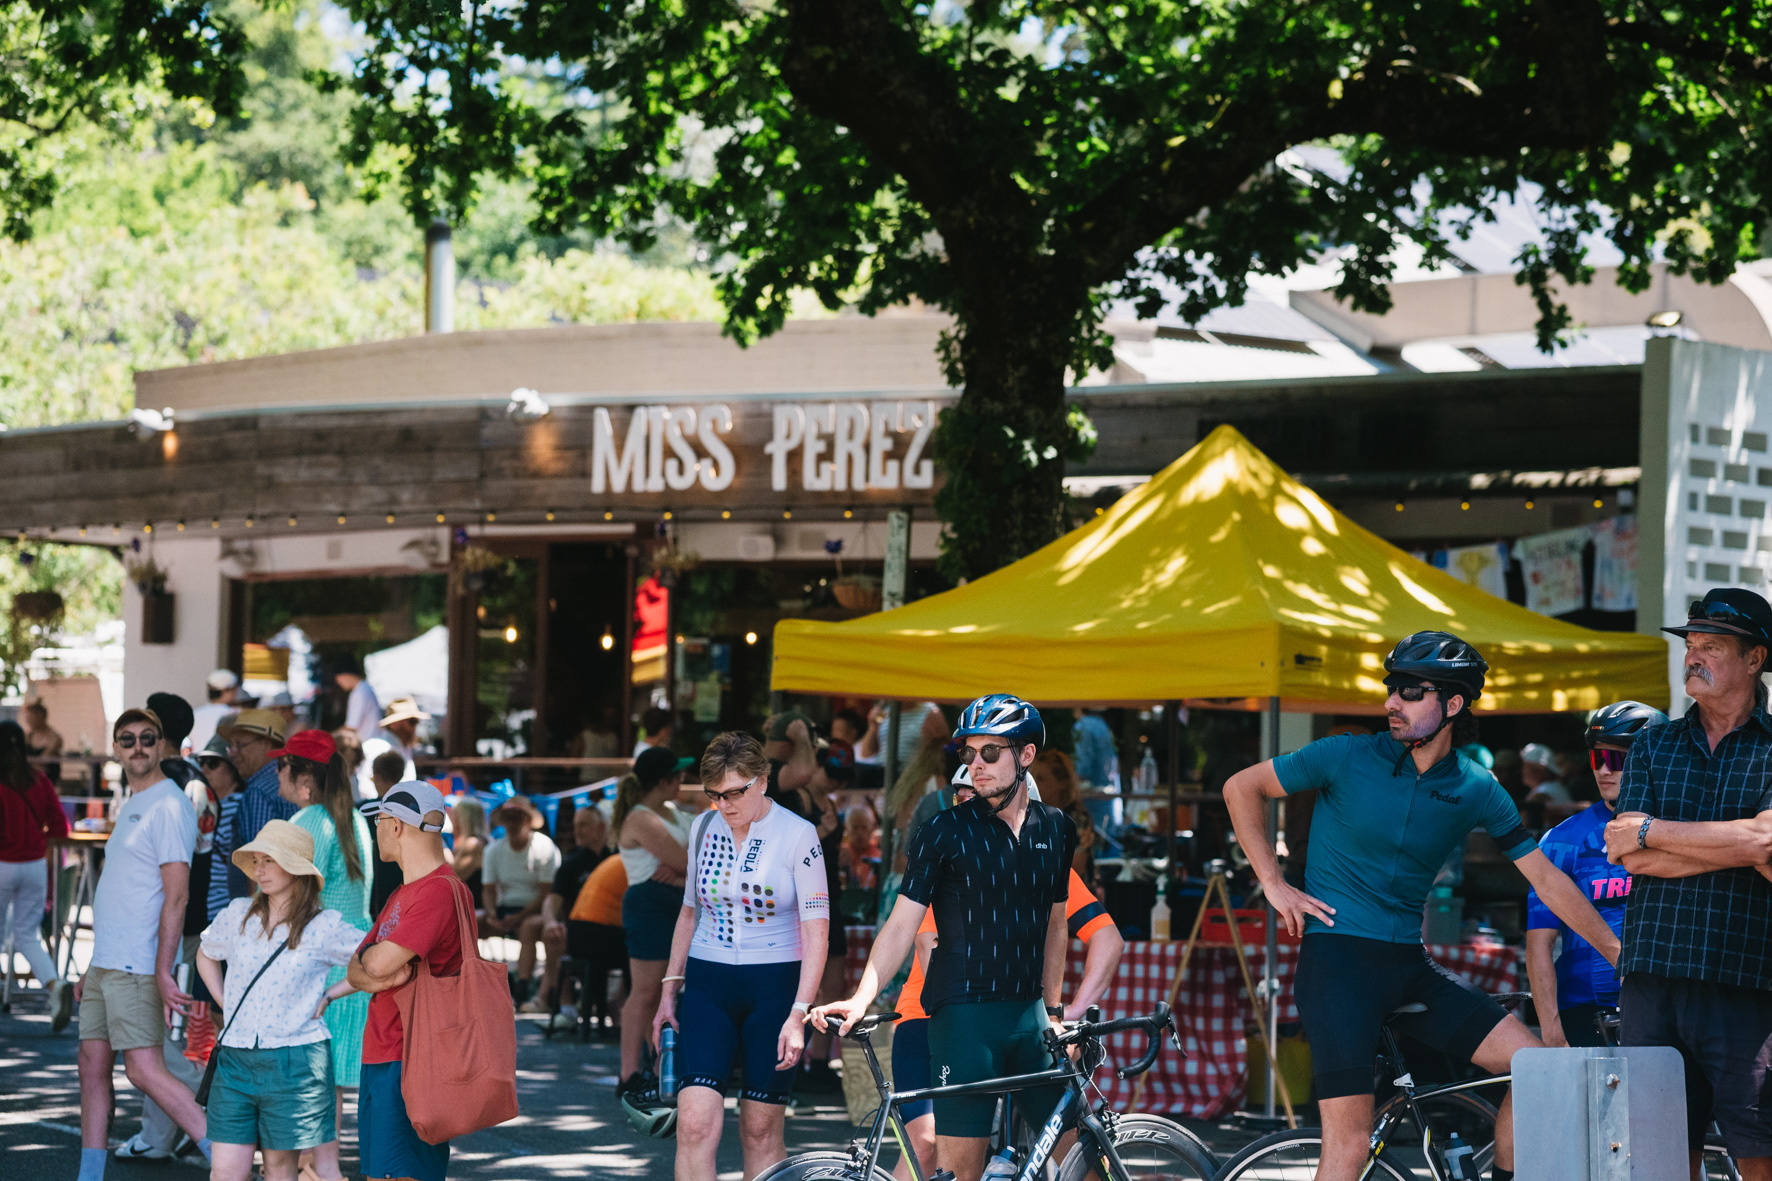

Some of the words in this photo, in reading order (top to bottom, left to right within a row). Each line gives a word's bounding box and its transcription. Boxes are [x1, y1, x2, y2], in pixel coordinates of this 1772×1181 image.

[591, 403, 736, 494] MISS
[764, 400, 936, 492] PEREZ
[1430, 790, 1462, 805] Pedal
[1035, 842, 1048, 850] dhb
[743, 838, 763, 873] PEDLA
[693, 1076, 718, 1086] MAAP
[746, 1090, 769, 1100] MAAP
